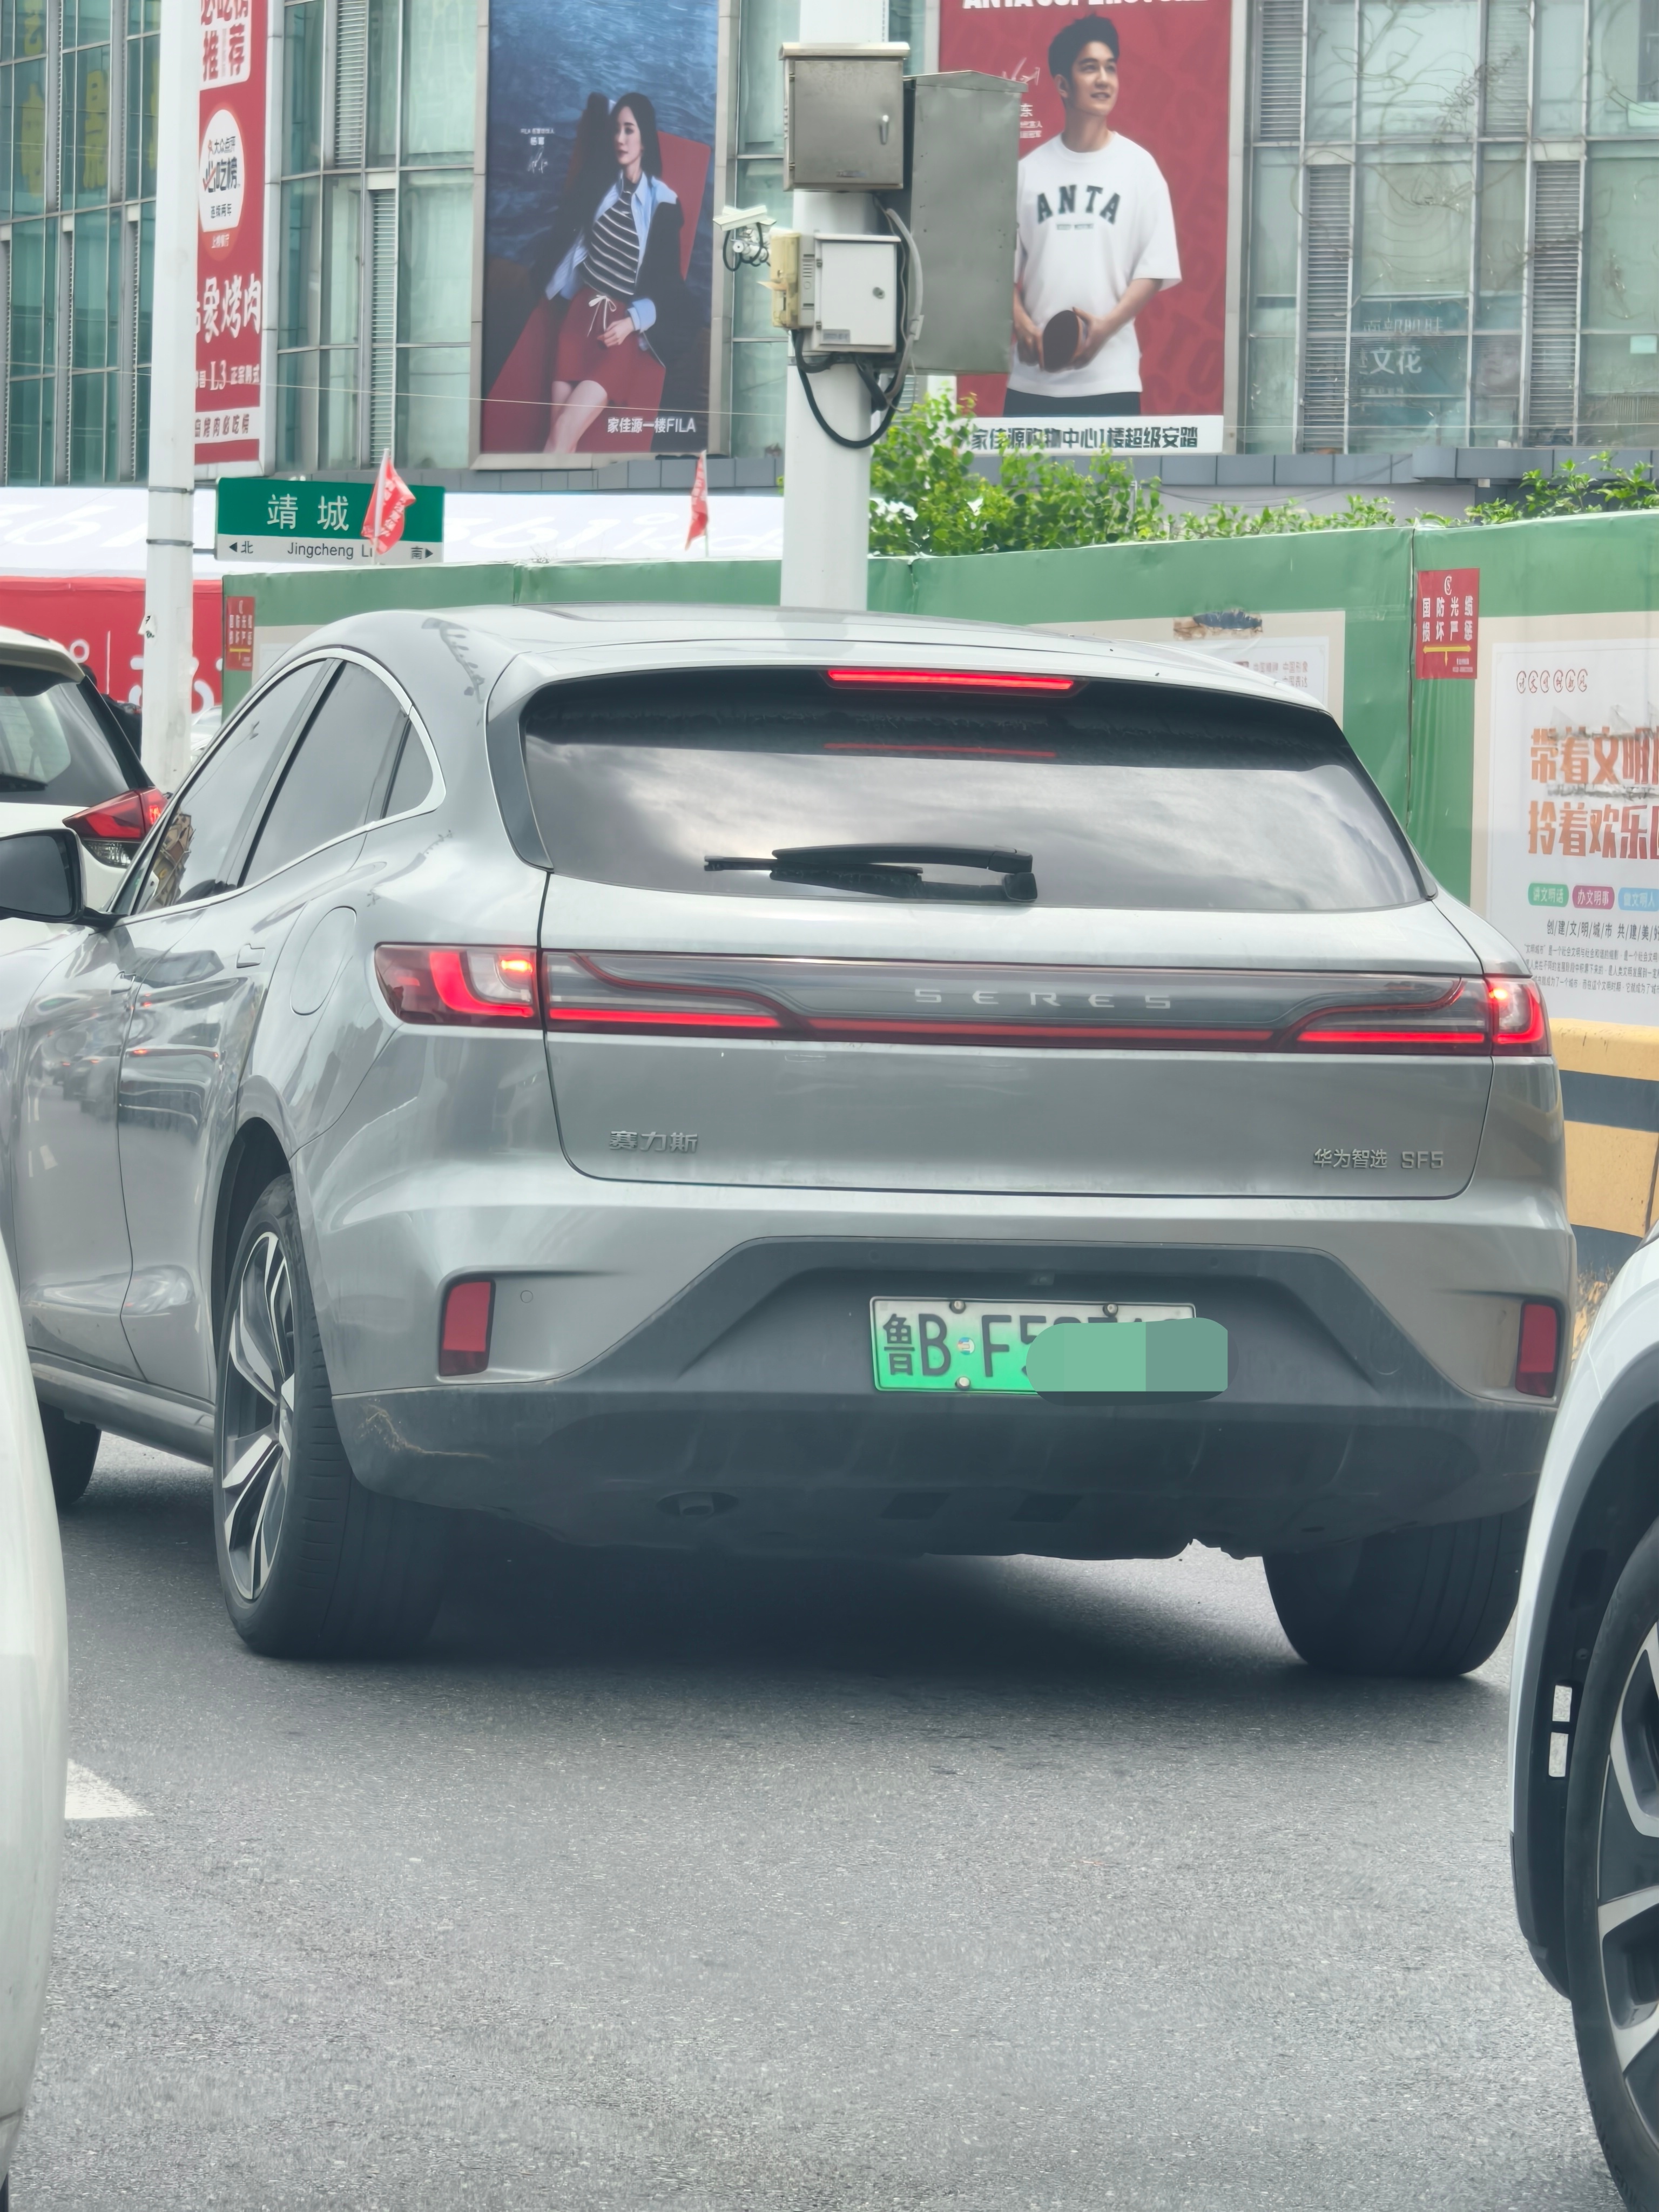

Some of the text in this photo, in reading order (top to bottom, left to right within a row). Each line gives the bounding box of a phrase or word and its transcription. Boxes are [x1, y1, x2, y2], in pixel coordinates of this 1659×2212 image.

[203, 23, 245, 82] 推荐
[214, 136, 236, 155] 大众点评
[203, 157, 238, 193] 必吃榜
[1037, 184, 1121, 225] ANTA
[607, 417, 697, 433] 家佳源一楼FILA
[240, 541, 254, 555] 北
[287, 542, 354, 560] Jingcheng
[410, 546, 423, 559] 南
[1422, 595, 1474, 618] 国防光缆
[1422, 620, 1474, 643] 损坏严惩
[1530, 726, 1659, 785] 带着文明
[1577, 889, 1610, 907] 办文明事
[914, 988, 1171, 1010] SERES
[609, 1130, 698, 1153] 赛力斯
[1313, 1148, 1444, 1169] 华为智选 SF5
